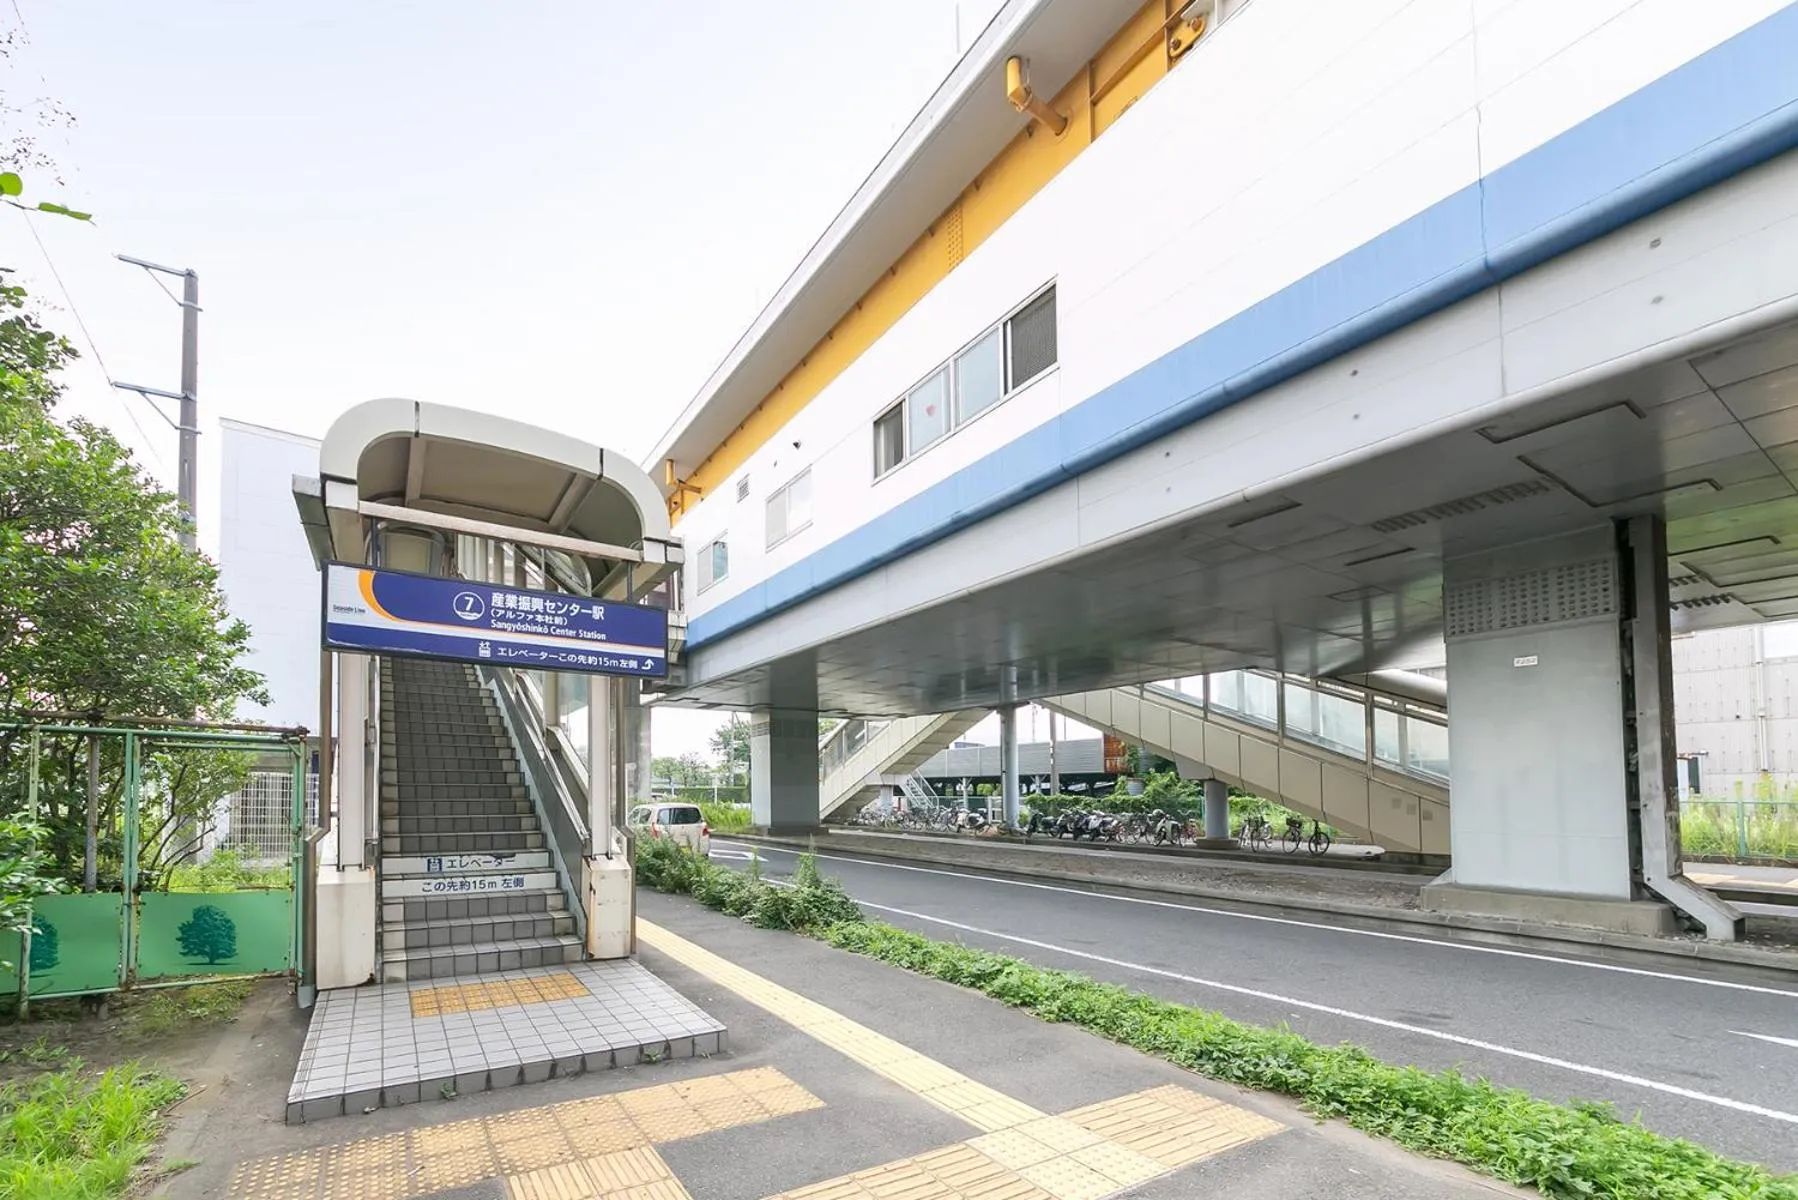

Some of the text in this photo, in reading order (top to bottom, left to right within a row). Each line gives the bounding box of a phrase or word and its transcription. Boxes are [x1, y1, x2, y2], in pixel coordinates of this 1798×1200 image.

[464, 596, 474, 611] 7
[491, 592, 605, 621] 産業振興センター駅
[550, 626, 577, 638] Center
[578, 630, 607, 641] Station
[497, 647, 639, 670] エレベーターこの先約15m左側
[446, 857, 516, 869] エレベーター
